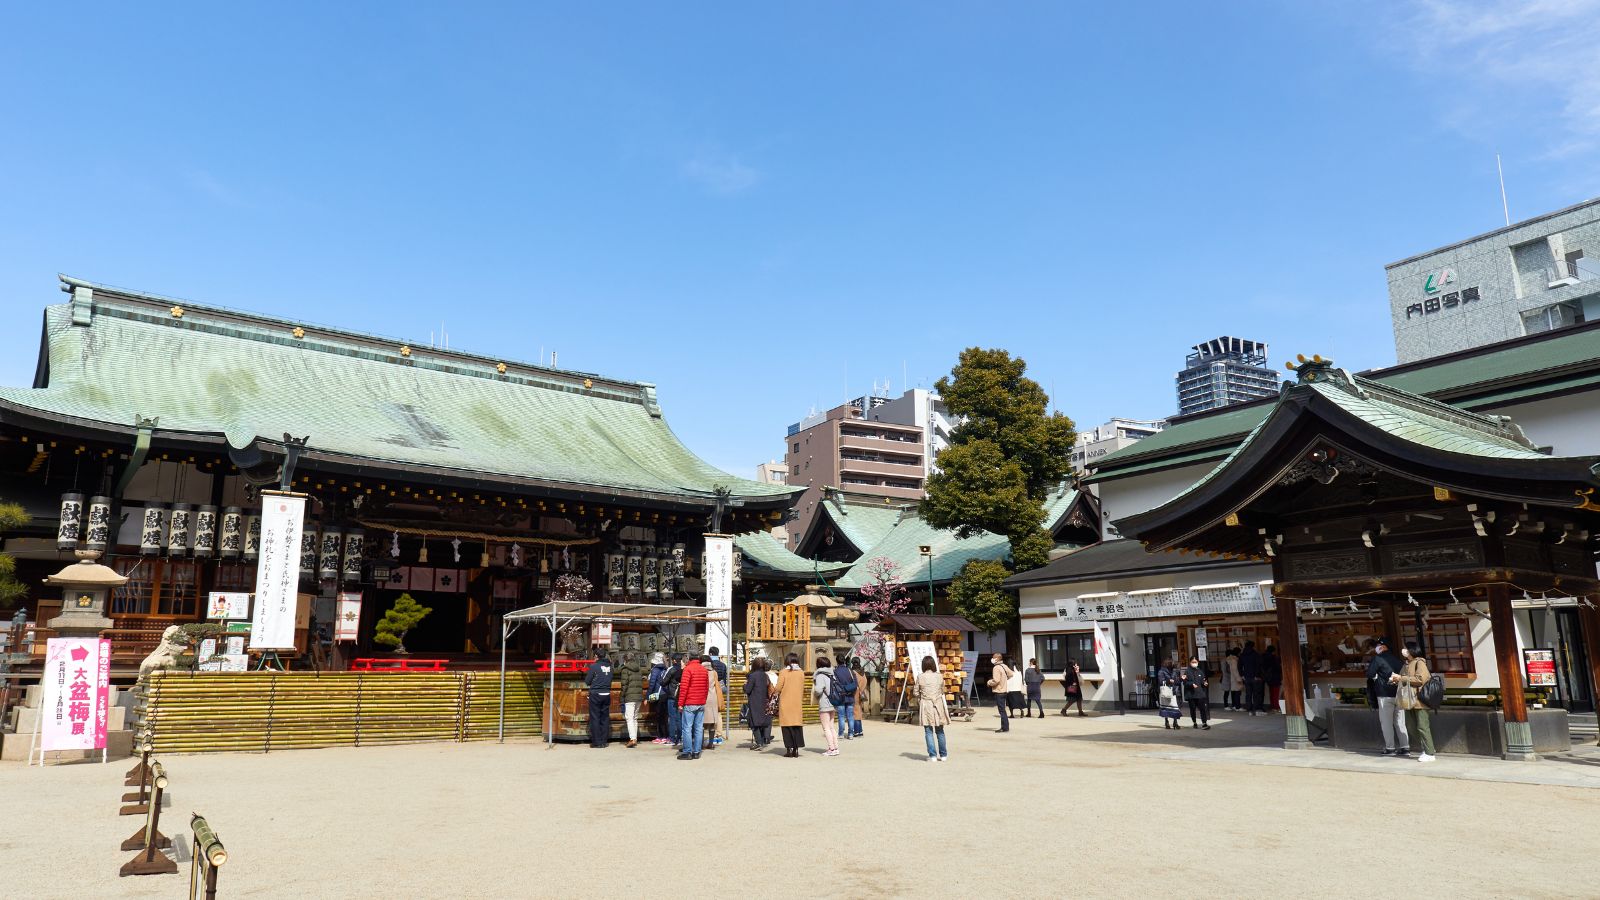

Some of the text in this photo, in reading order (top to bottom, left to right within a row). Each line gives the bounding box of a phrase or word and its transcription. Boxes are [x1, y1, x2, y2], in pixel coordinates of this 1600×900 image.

[1406, 286, 1480, 319] 内田写真
[1087, 448, 1107, 458] ANNEX
[68, 667, 92, 735] 大盆梅展
